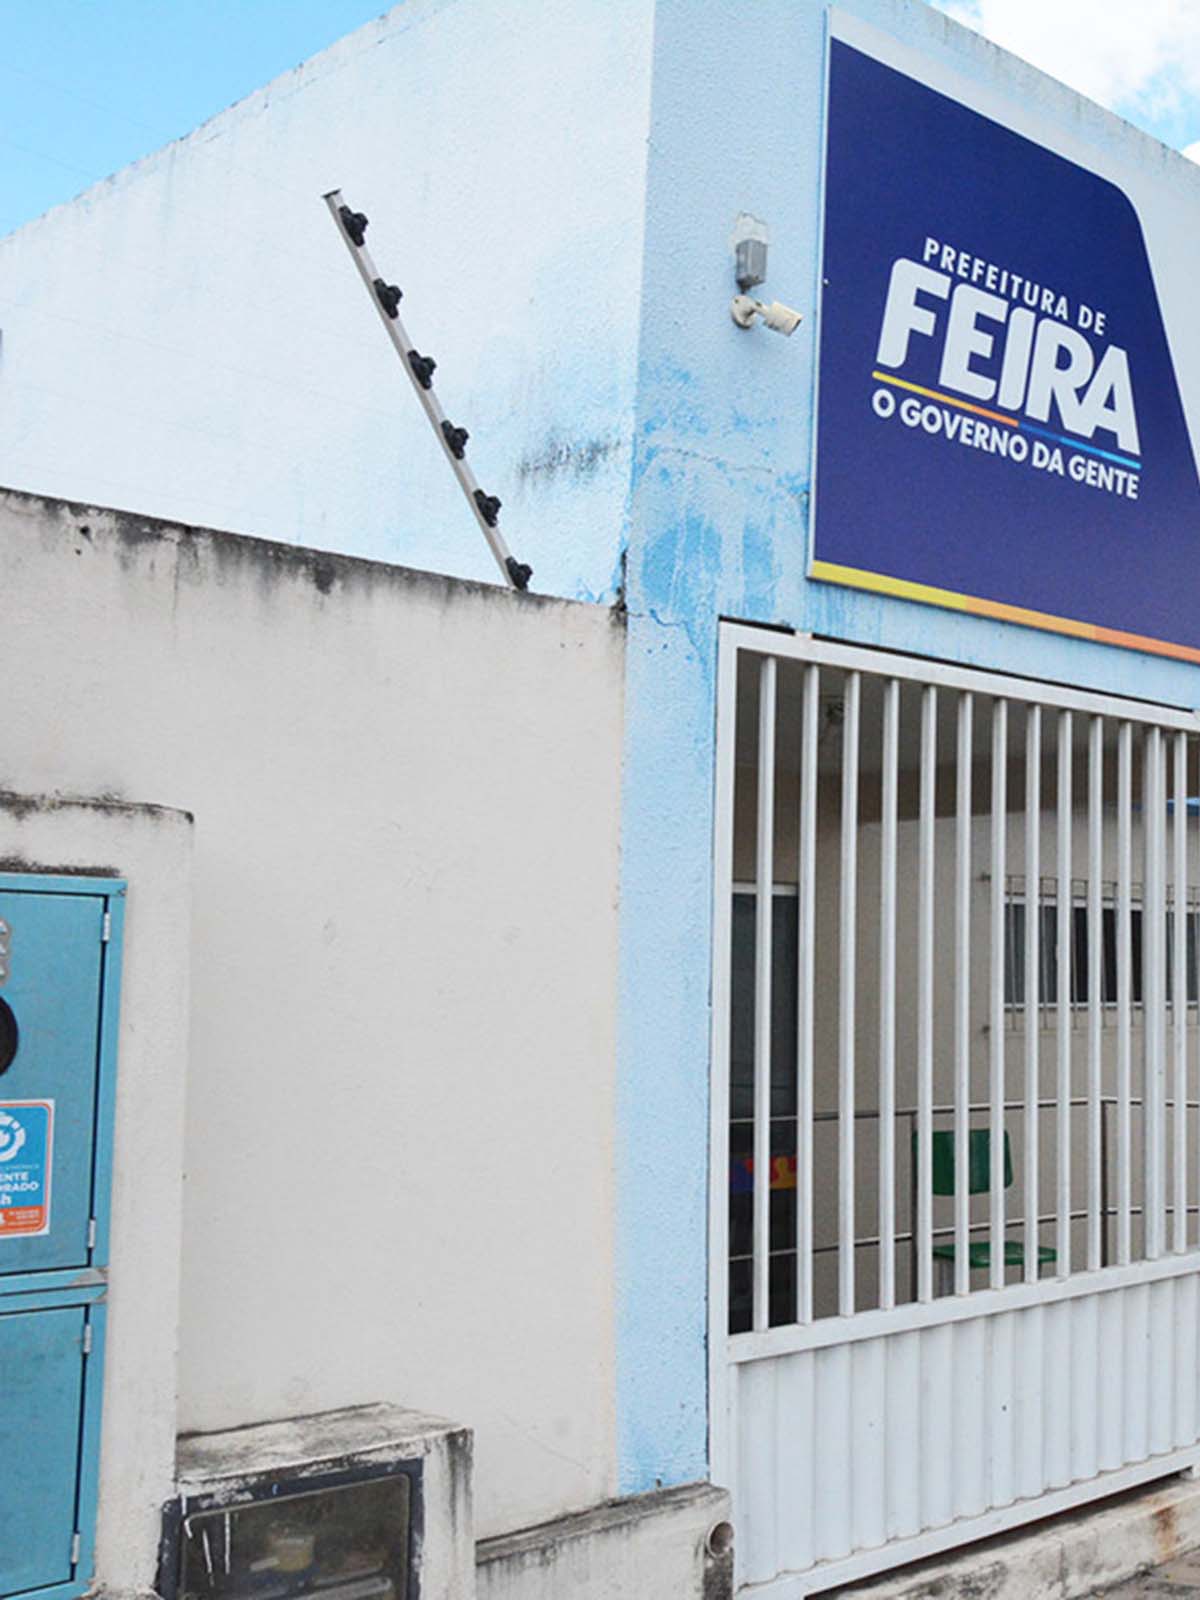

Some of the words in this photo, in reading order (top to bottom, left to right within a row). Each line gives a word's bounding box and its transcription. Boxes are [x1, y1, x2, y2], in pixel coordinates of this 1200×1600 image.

[923, 237, 1068, 320] PREFEITURA
[1077, 304, 1107, 336] DE
[876, 258, 1141, 456] FEIRA
[872, 388, 896, 418] O
[899, 397, 1029, 462] GOVERNO
[1031, 445, 1065, 476] DA
[1068, 455, 1140, 499] GENTE
